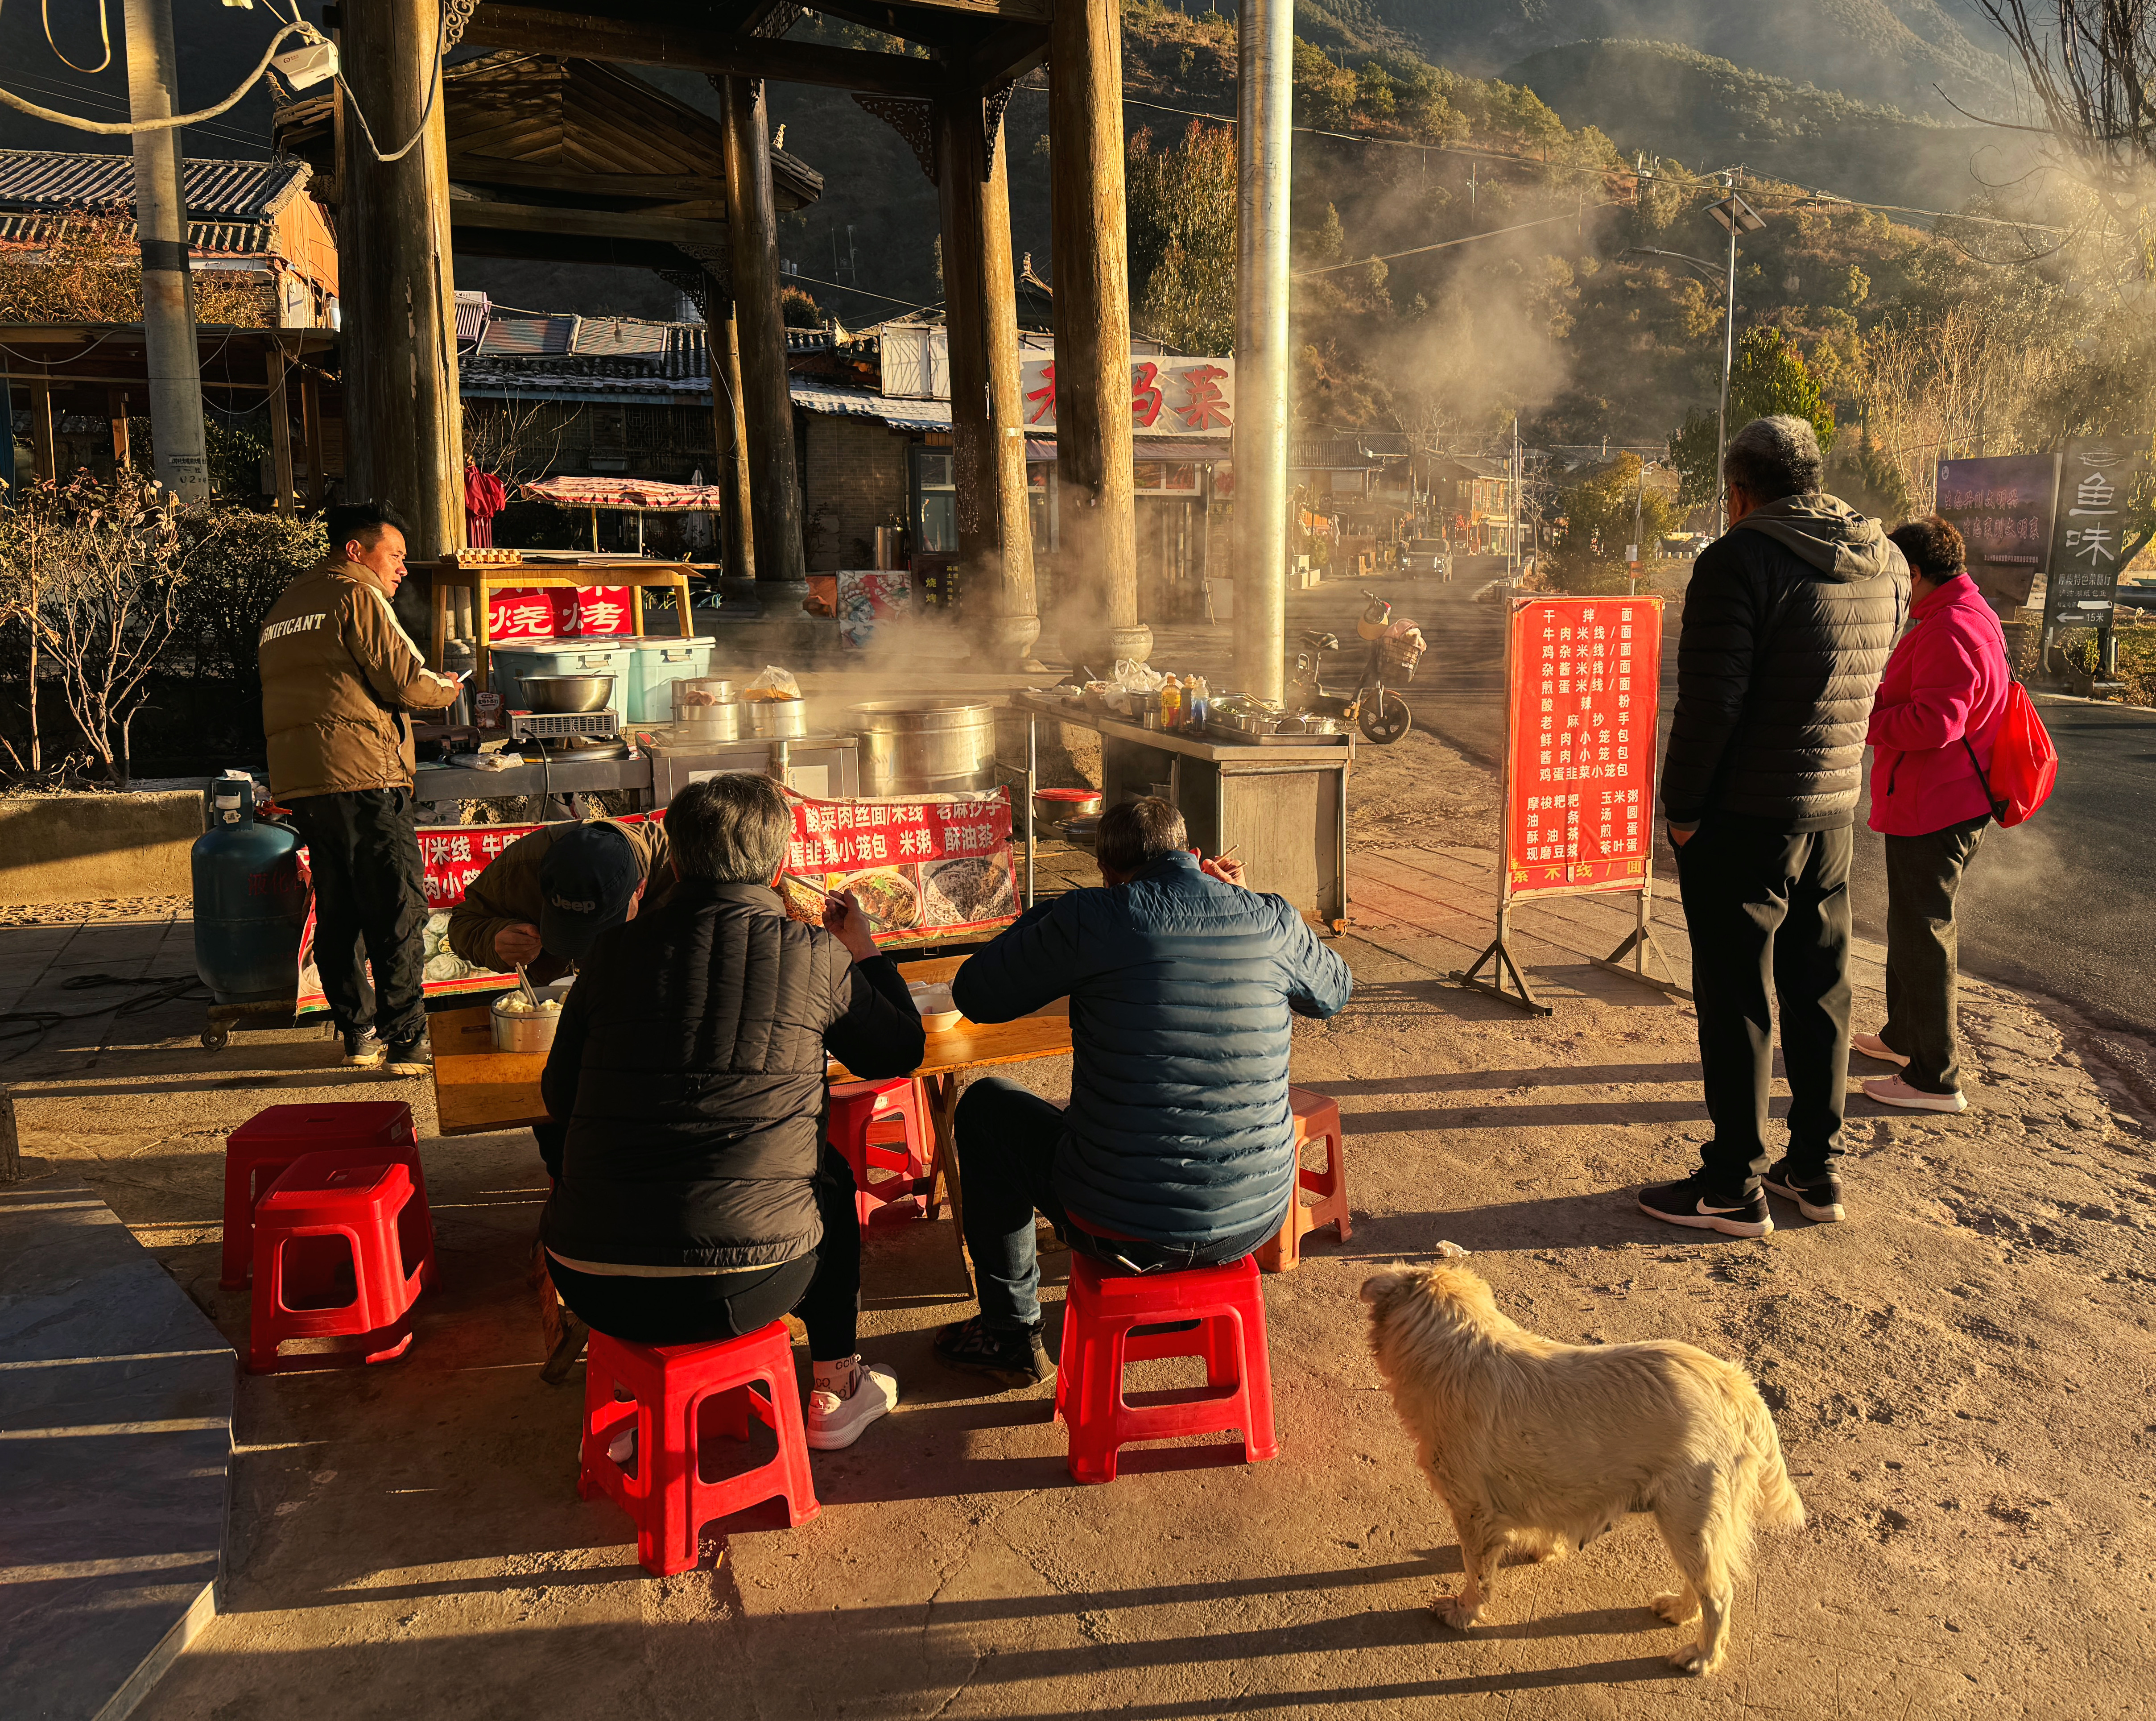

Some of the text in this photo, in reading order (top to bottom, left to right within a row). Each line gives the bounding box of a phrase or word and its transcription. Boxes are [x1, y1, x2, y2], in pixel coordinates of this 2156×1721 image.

[2065, 472, 2118, 566] 鱼味
[1544, 608, 1632, 623] 干拌面
[2086, 612, 2104, 623] 15米
[1543, 625, 1632, 641] 牛肉米线/面
[1542, 642, 1631, 659] 鸡杂米线/面
[1542, 660, 1631, 677] 杂酱米线/面
[1541, 677, 1630, 695] 煎蛋米线/面
[1541, 694, 1630, 712] 酸辣粉
[1541, 712, 1629, 730] 老麻抄手
[1540, 729, 1629, 747] 鲜肉小笼包
[1540, 746, 1628, 765] 酱肉小笼包
[1540, 763, 1628, 782] 鸡蛋韭菜小笼包
[1527, 789, 1638, 811] 摩梭粑粑 玉米粥
[805, 806, 923, 834] 酸菜肉丝面/米线
[1527, 805, 1638, 827] 油条 汤圆
[1527, 822, 1638, 844] 酥油茶 煎蛋
[418, 836, 471, 867] /米线
[786, 823, 995, 868] 蛋韭菜小笼包 米粥 酥油茶
[1526, 838, 1637, 861] 现磨豆浆 茶叶蛋
[551, 894, 596, 914] Jeep
